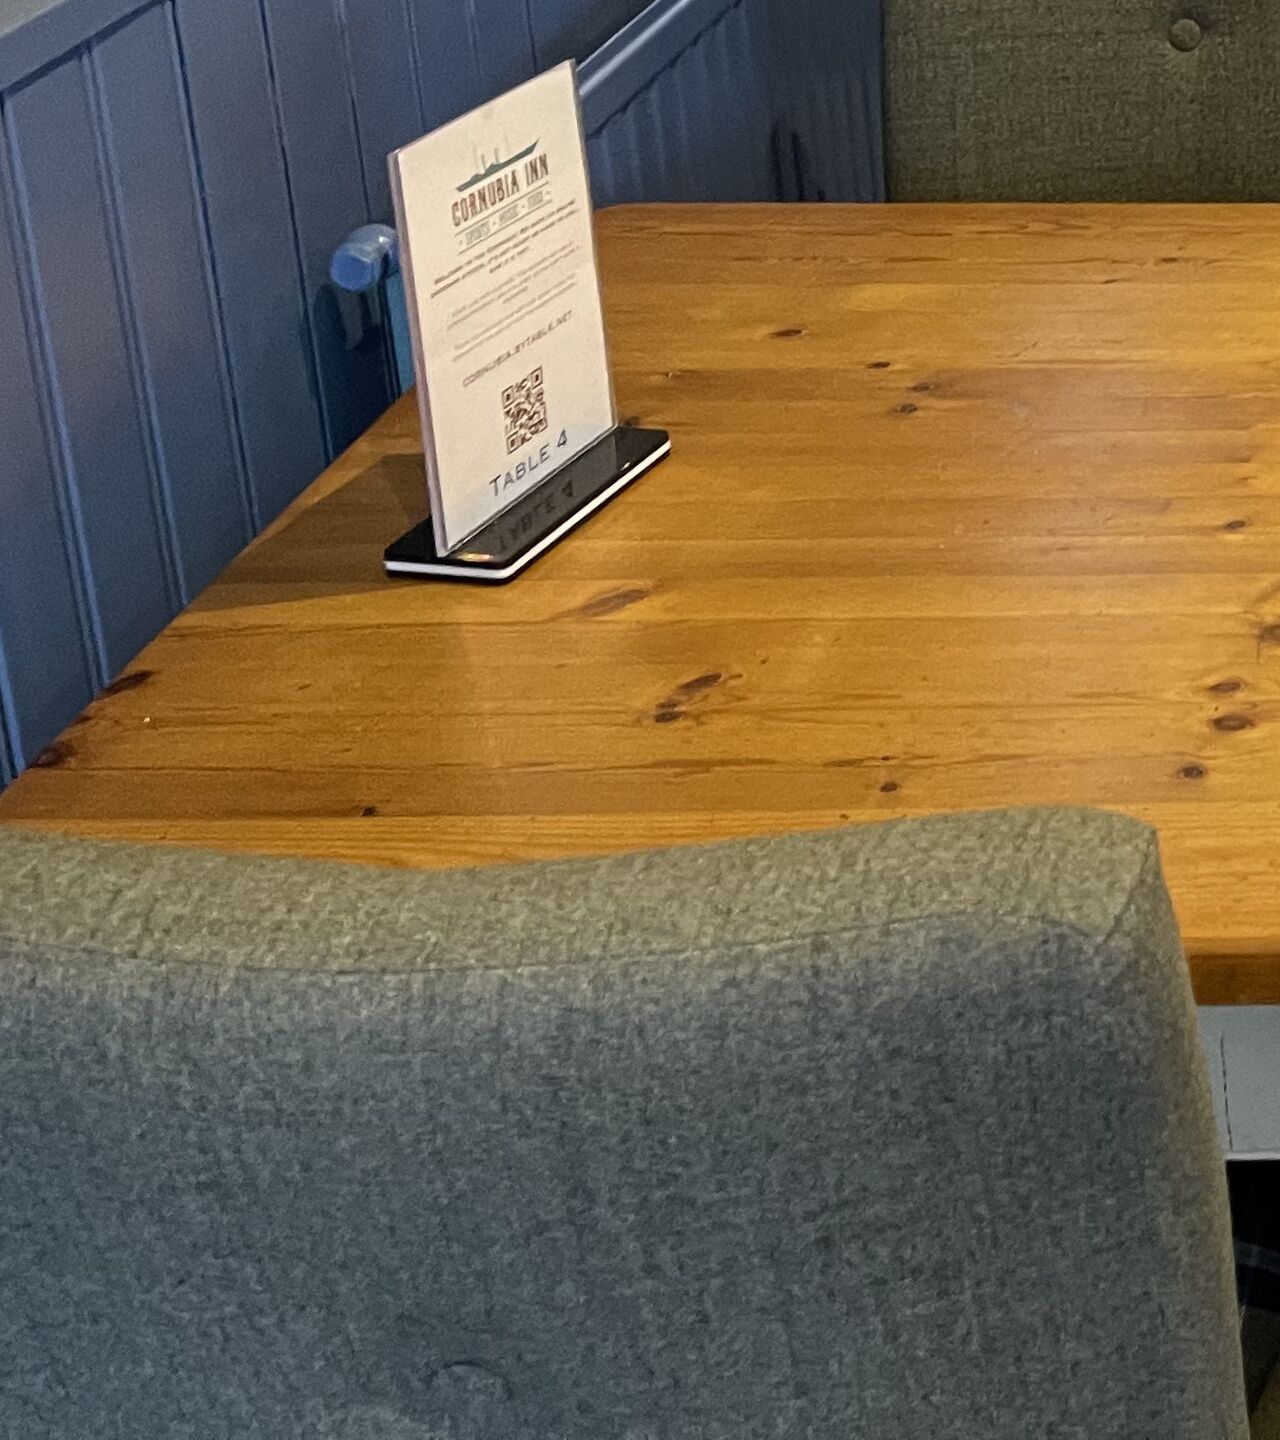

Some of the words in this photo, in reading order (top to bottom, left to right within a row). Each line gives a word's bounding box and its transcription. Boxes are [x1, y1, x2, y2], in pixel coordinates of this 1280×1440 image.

[451, 168, 520, 227] CORNUBIA
[525, 153, 549, 187] INN
[556, 428, 568, 448] 4
